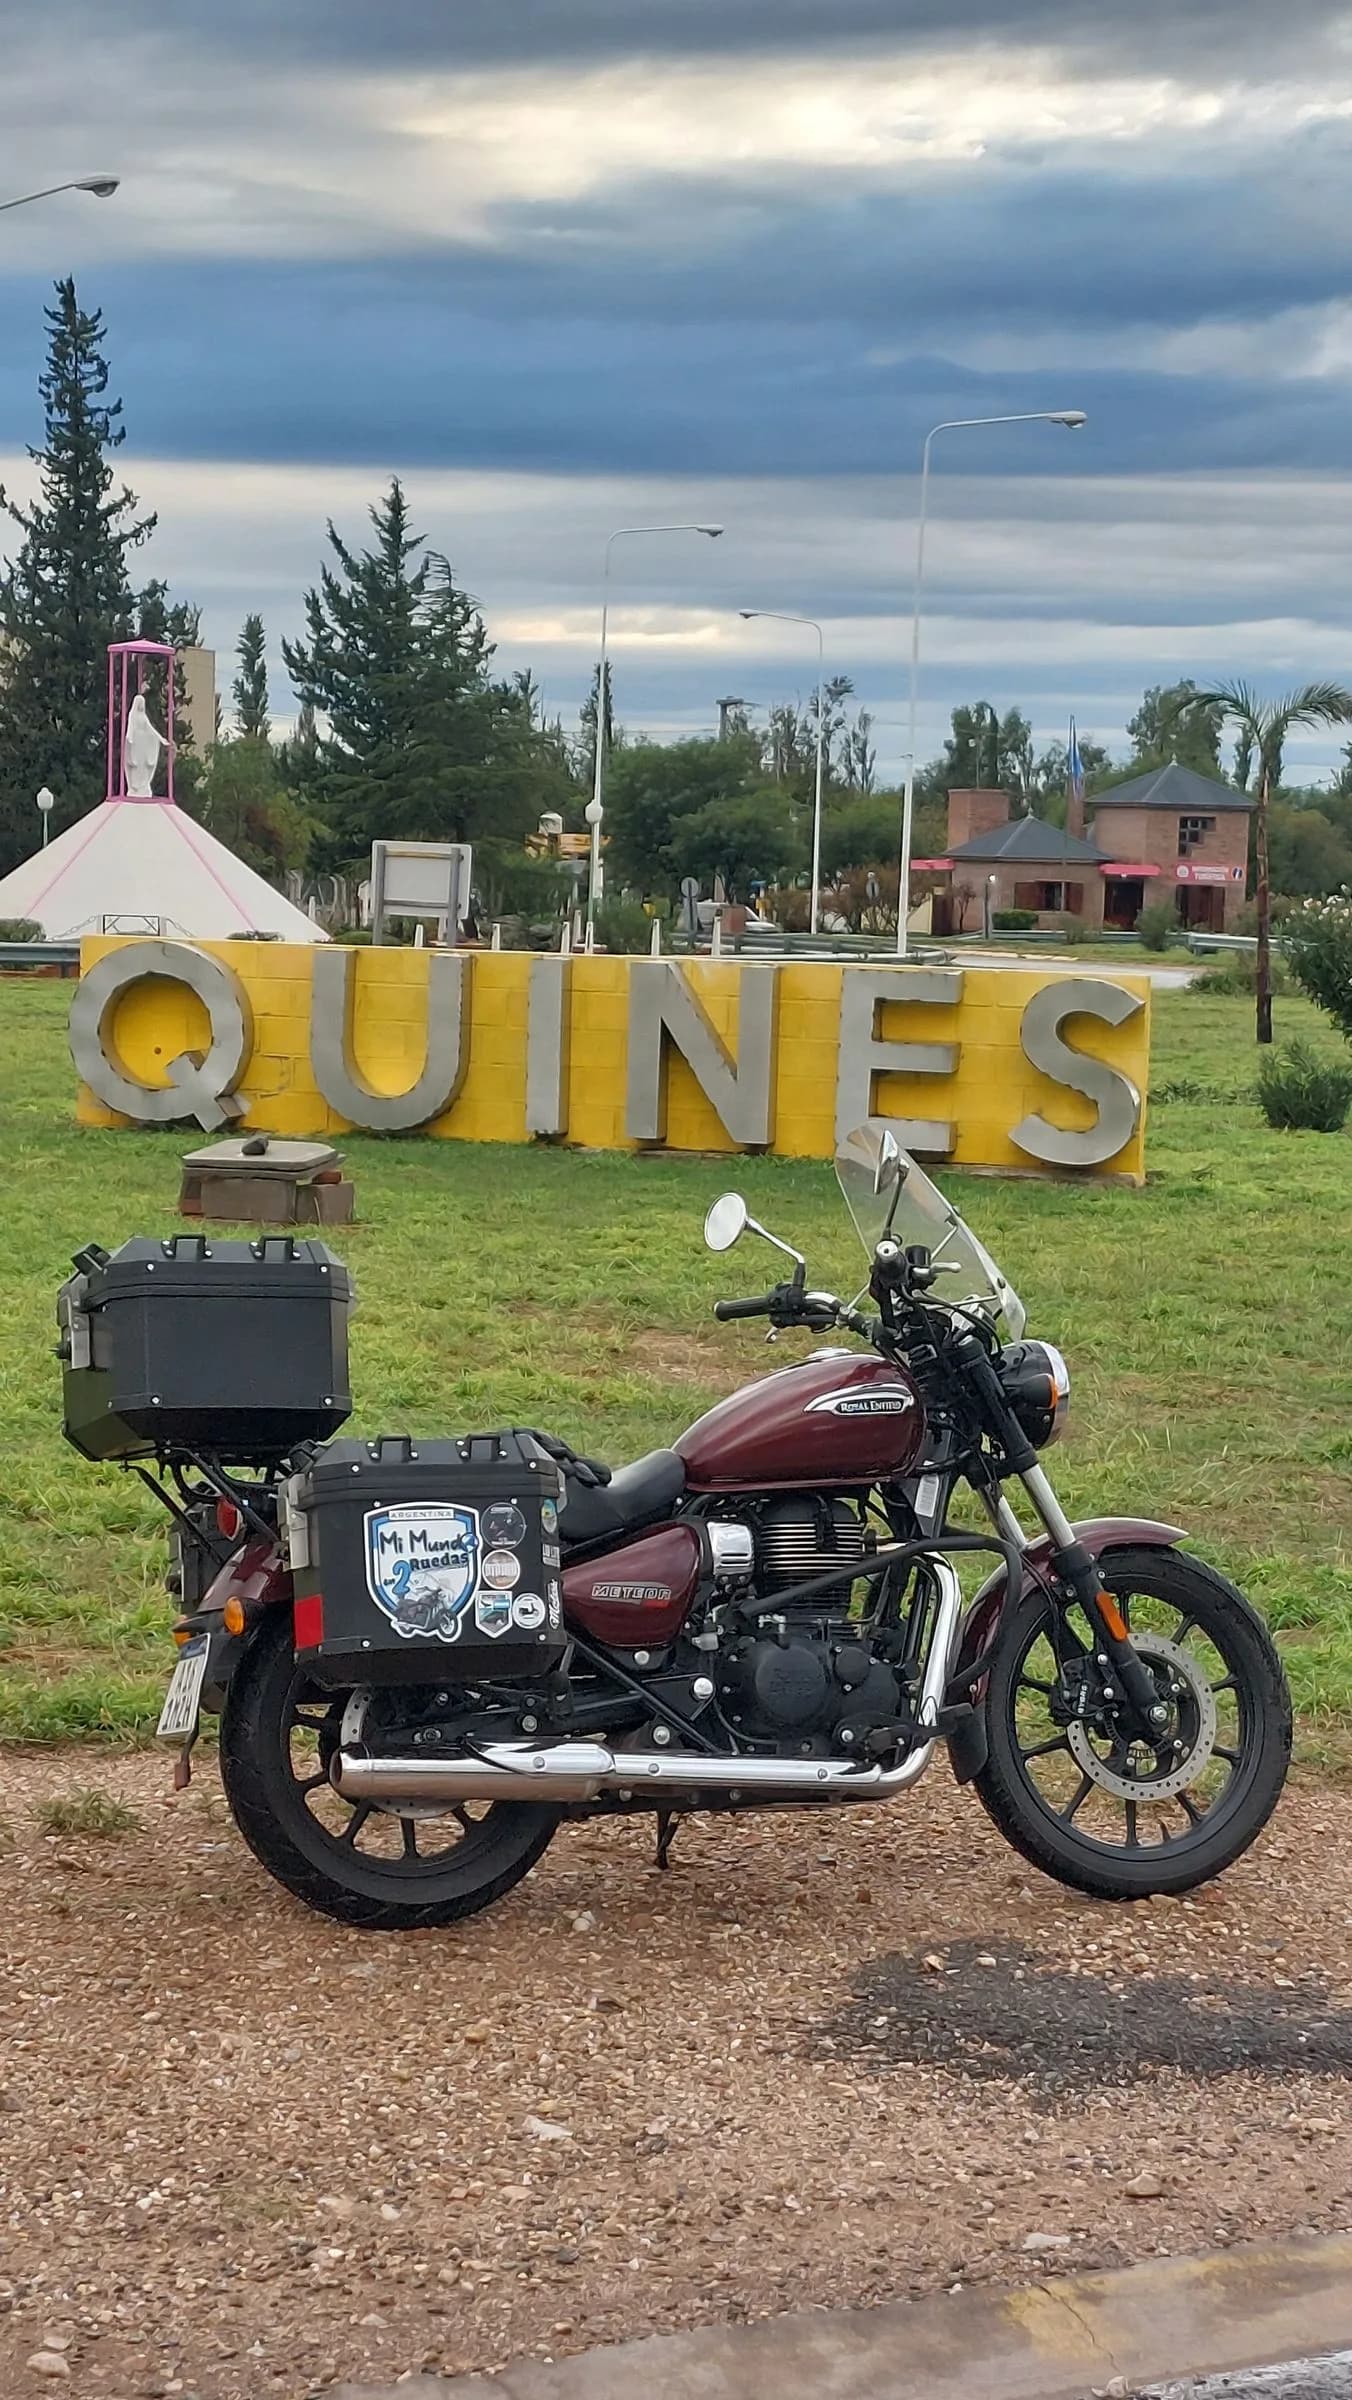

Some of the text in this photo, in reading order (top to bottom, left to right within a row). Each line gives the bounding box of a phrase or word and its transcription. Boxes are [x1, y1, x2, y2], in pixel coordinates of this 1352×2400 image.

[68, 941, 1145, 1166] QUINES
[380, 1530, 403, 1555] Mi
[392, 1560, 411, 1595] 2
[409, 1553, 469, 1572] Ruedas
[592, 1585, 672, 1600] METEOR
